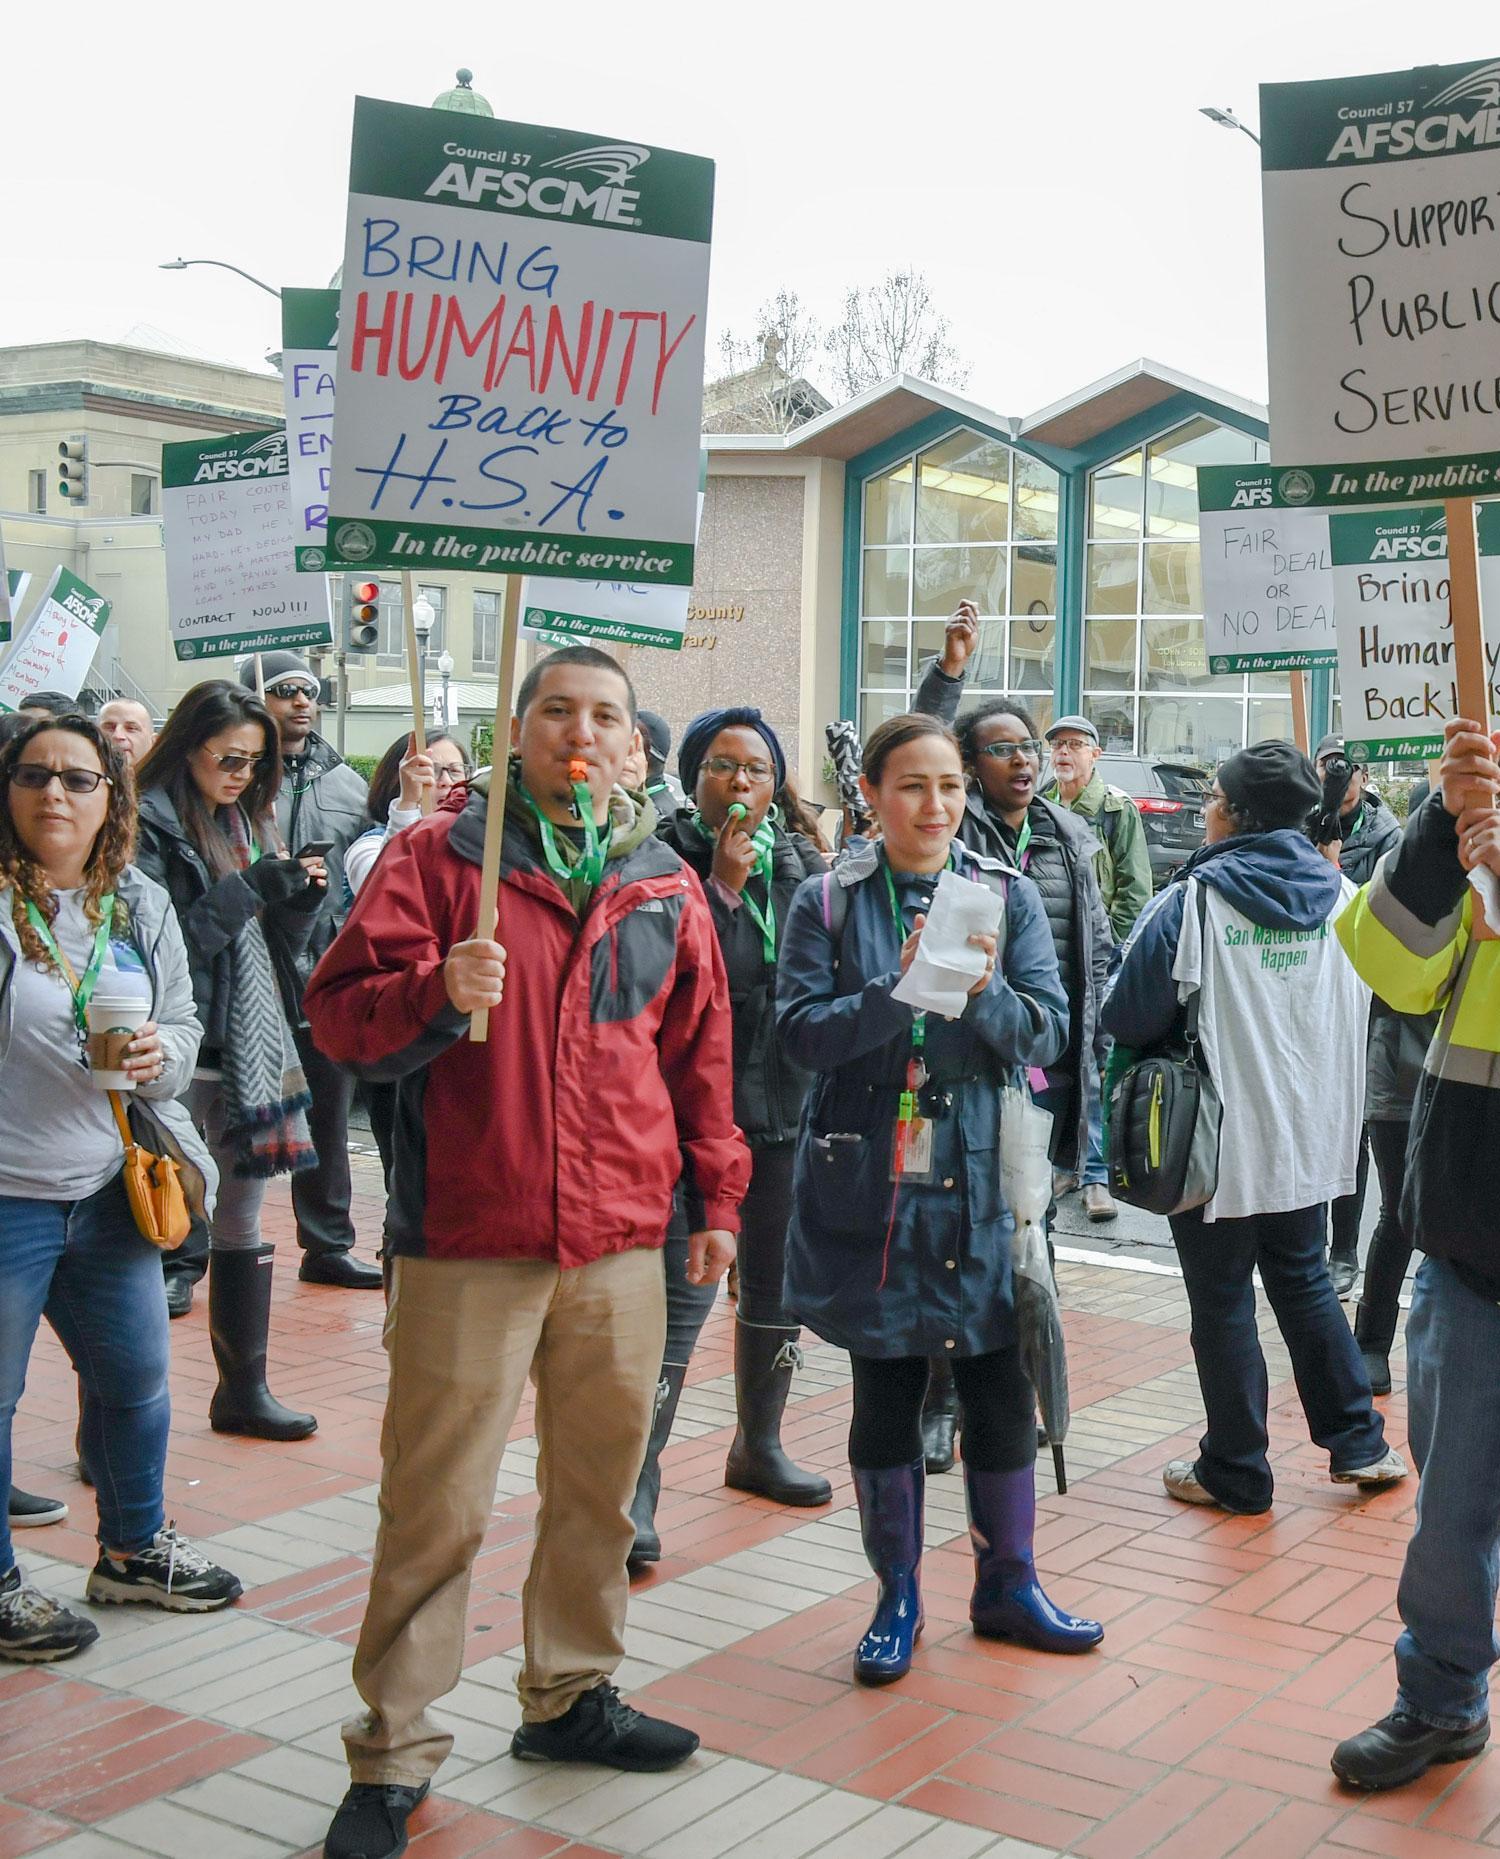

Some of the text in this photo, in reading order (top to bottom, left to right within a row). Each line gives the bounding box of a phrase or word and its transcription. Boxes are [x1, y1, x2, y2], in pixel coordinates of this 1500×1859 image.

[1338, 100, 1414, 121] Council 57
[443, 142, 532, 168] Council 57
[424, 162, 641, 226] AFSCME
[362, 217, 560, 298] BRING
[350, 289, 697, 416] HUMANITY
[428, 394, 629, 449] Back to
[198, 450, 238, 460] Council 57
[193, 455, 290, 482] AFSCME
[1327, 472, 1358, 497] In
[1360, 470, 1404, 494] the
[1405, 461, 1491, 496] public
[354, 433, 626, 532] H.S.A.
[1235, 478, 1272, 488] Council 57
[186, 490, 229, 512] FAIR
[1230, 487, 1273, 508] AFS
[189, 500, 289, 528] TODAY FOR
[218, 528, 242, 540] DAD
[262, 520, 278, 530] HE
[1224, 526, 1279, 560] FAIR
[1374, 525, 1420, 536] Council 57
[390, 532, 674, 574] In the public service
[1369, 535, 1449, 561] AFSC
[1274, 550, 1332, 576] DEAL
[1266, 583, 1290, 600] OR
[1357, 572, 1454, 630] Bring
[178, 612, 236, 629] CONTRACT
[550, 616, 674, 645] In the public service
[1222, 610, 1259, 637] NO
[201, 630, 323, 653] In the public service
[1235, 658, 1252, 670] In
[1252, 656, 1272, 668] the
[1272, 654, 1312, 670] public
[1364, 682, 1446, 722] Back
[1376, 742, 1397, 757] In
[1398, 740, 1422, 756] the
[1224, 924, 1249, 946] San
[1260, 948, 1308, 973] Happen
